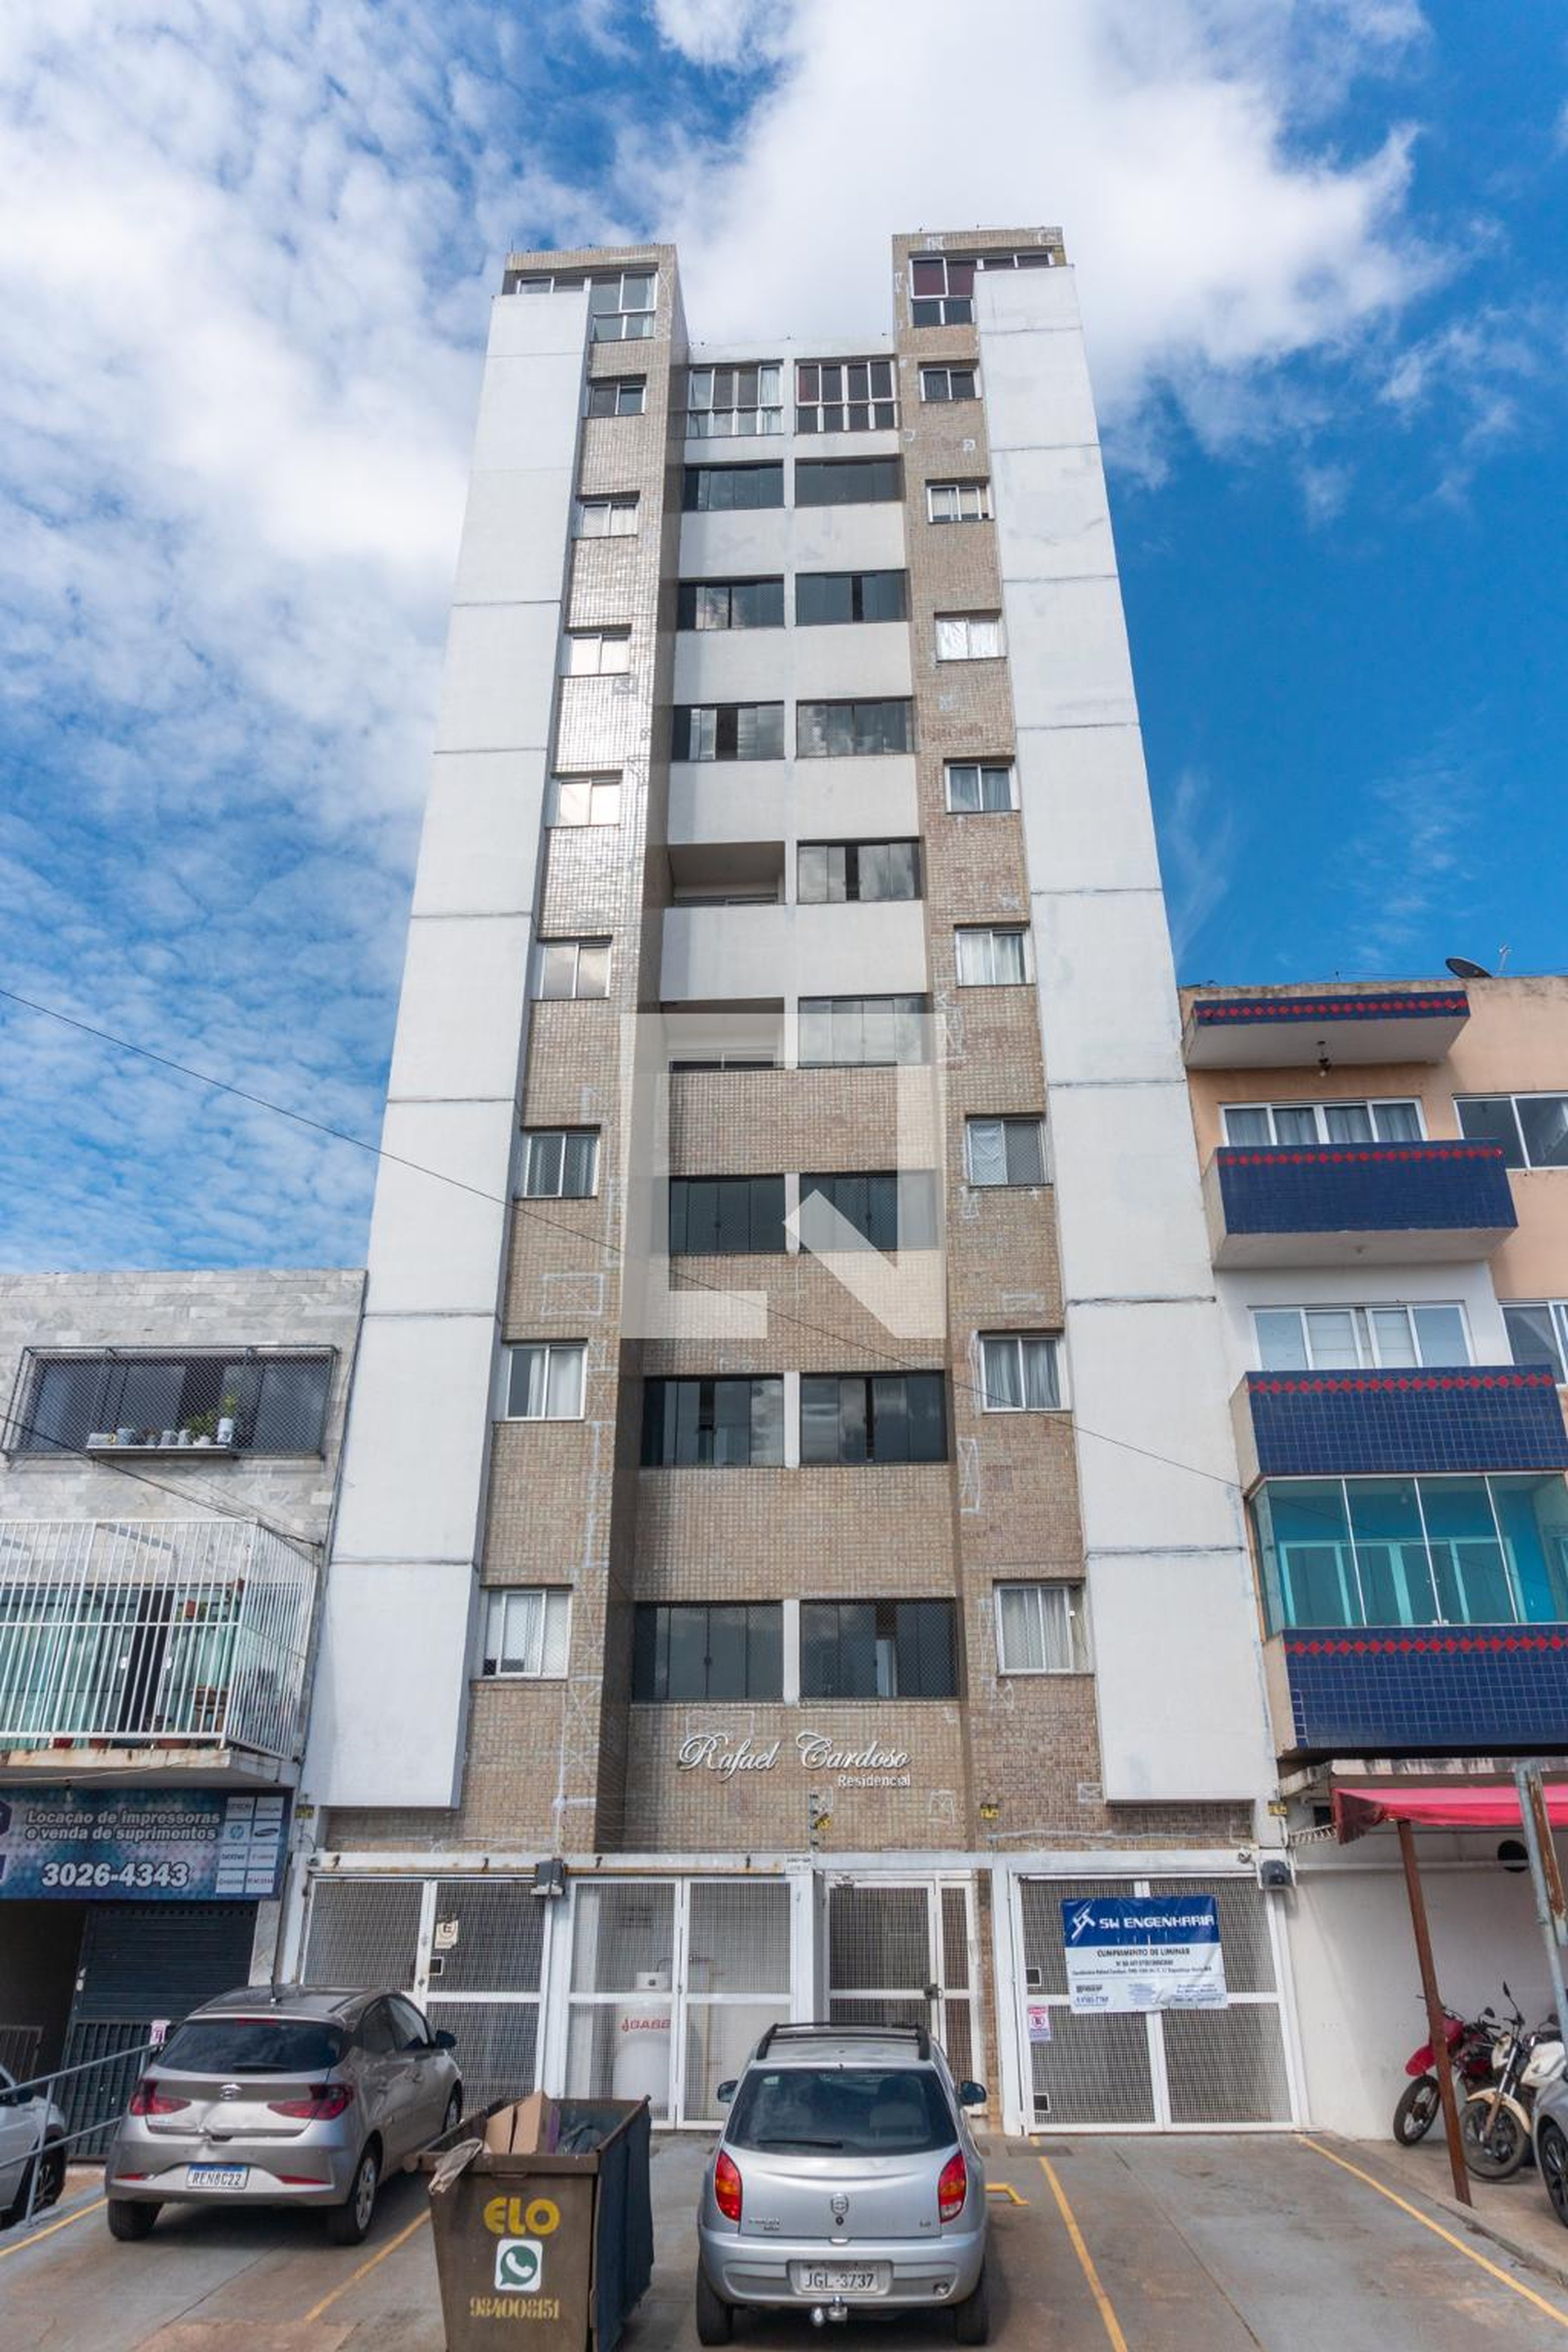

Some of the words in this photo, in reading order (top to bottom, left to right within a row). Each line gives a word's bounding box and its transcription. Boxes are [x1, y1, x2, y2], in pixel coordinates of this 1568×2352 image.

[677, 1733, 780, 1782] Rafael
[796, 1731, 911, 1771] Cardoso
[837, 1774, 911, 1787] Residencial
[97, 1811, 117, 1824] de
[122, 1810, 221, 1826] impressoras
[26, 1827, 38, 1840] e
[40, 1825, 88, 1840] venda
[92, 1825, 113, 1840] de
[116, 1826, 216, 1843] suprimentos
[42, 1862, 189, 1887] 3026-4343
[1099, 1918, 1120, 1929] SW
[1123, 1915, 1215, 1928] ENGENHARIA
[483, 2196, 561, 2235] ELO
[805, 2272, 874, 2289] JGL-3737
